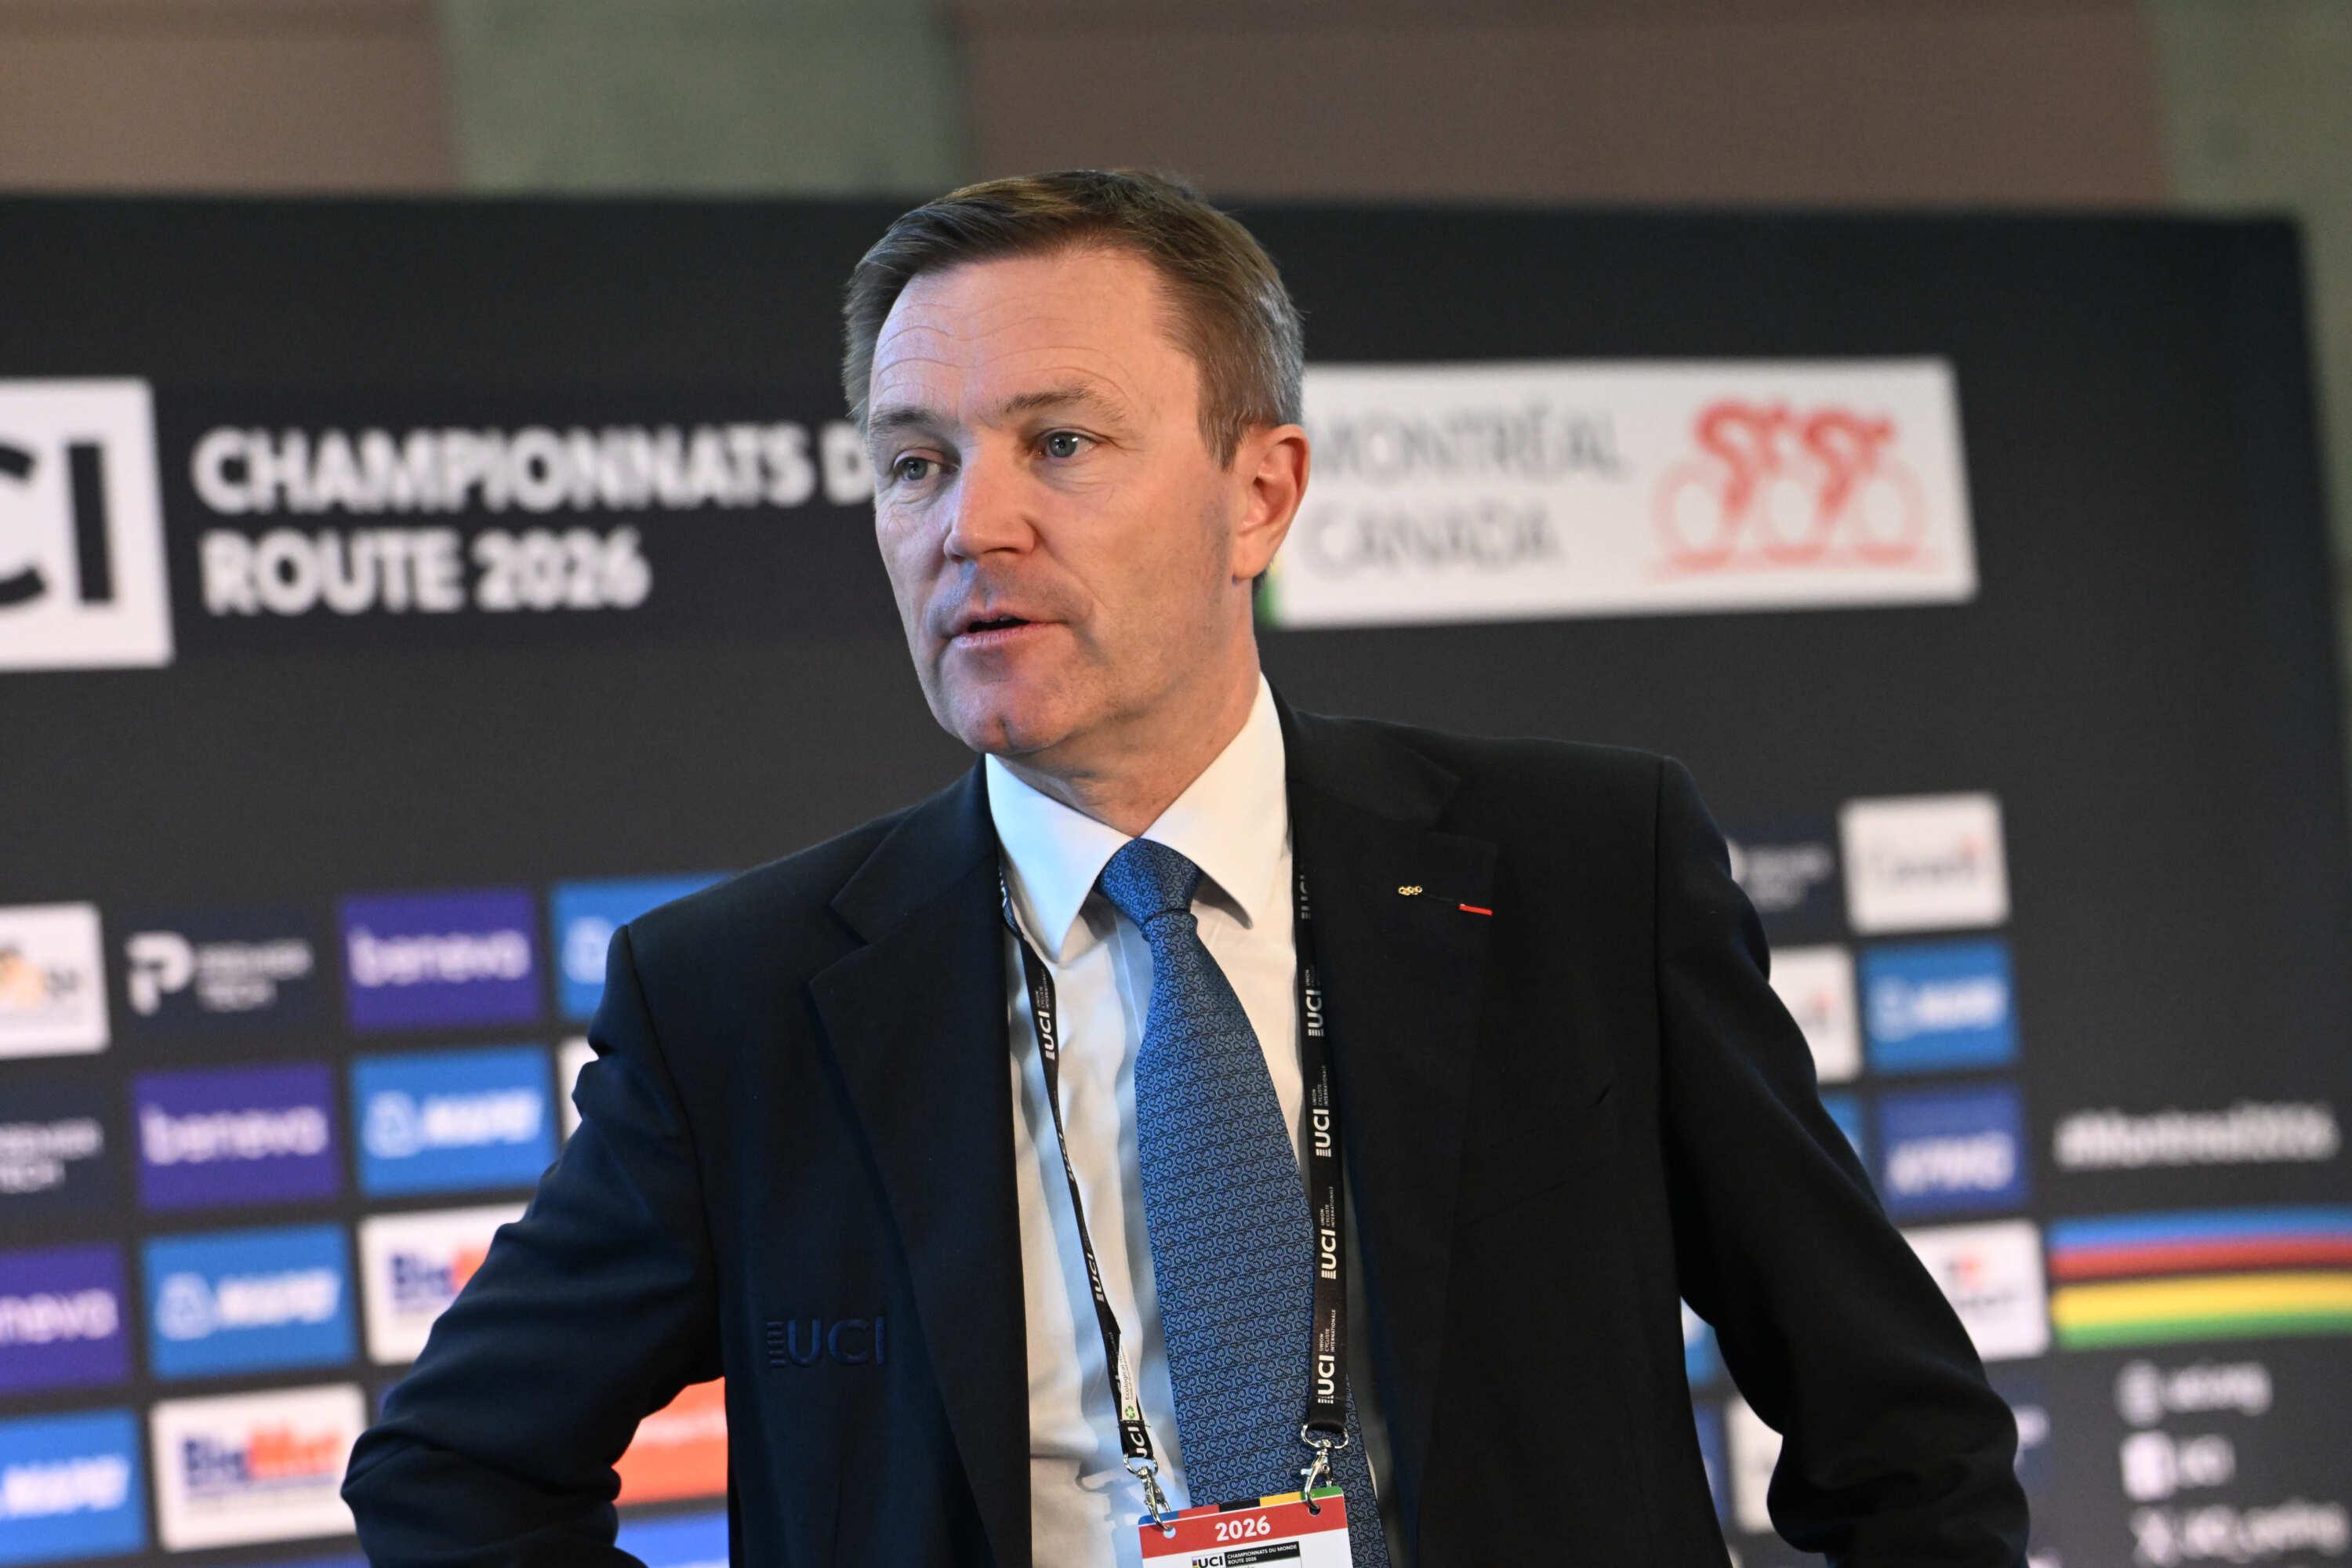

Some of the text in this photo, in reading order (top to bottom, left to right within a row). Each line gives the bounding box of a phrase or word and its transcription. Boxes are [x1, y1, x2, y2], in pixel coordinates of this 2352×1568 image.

[192, 422, 874, 514] CHAMPIONNATS D
[200, 526, 652, 616] ROUTE 2026
[1305, 989, 1323, 1028] UCI
[1038, 1010, 1054, 1051] UCI
[1312, 1109, 1331, 1149] UCI
[1321, 1229, 1337, 1270] UCI
[786, 1317, 886, 1367] UCI
[1318, 1355, 1335, 1396] UCI
[1215, 1515, 1271, 1541] 2026
[1198, 1556, 1223, 1568] UCI
[1227, 1549, 1268, 1559] CHAMPIONNATS
